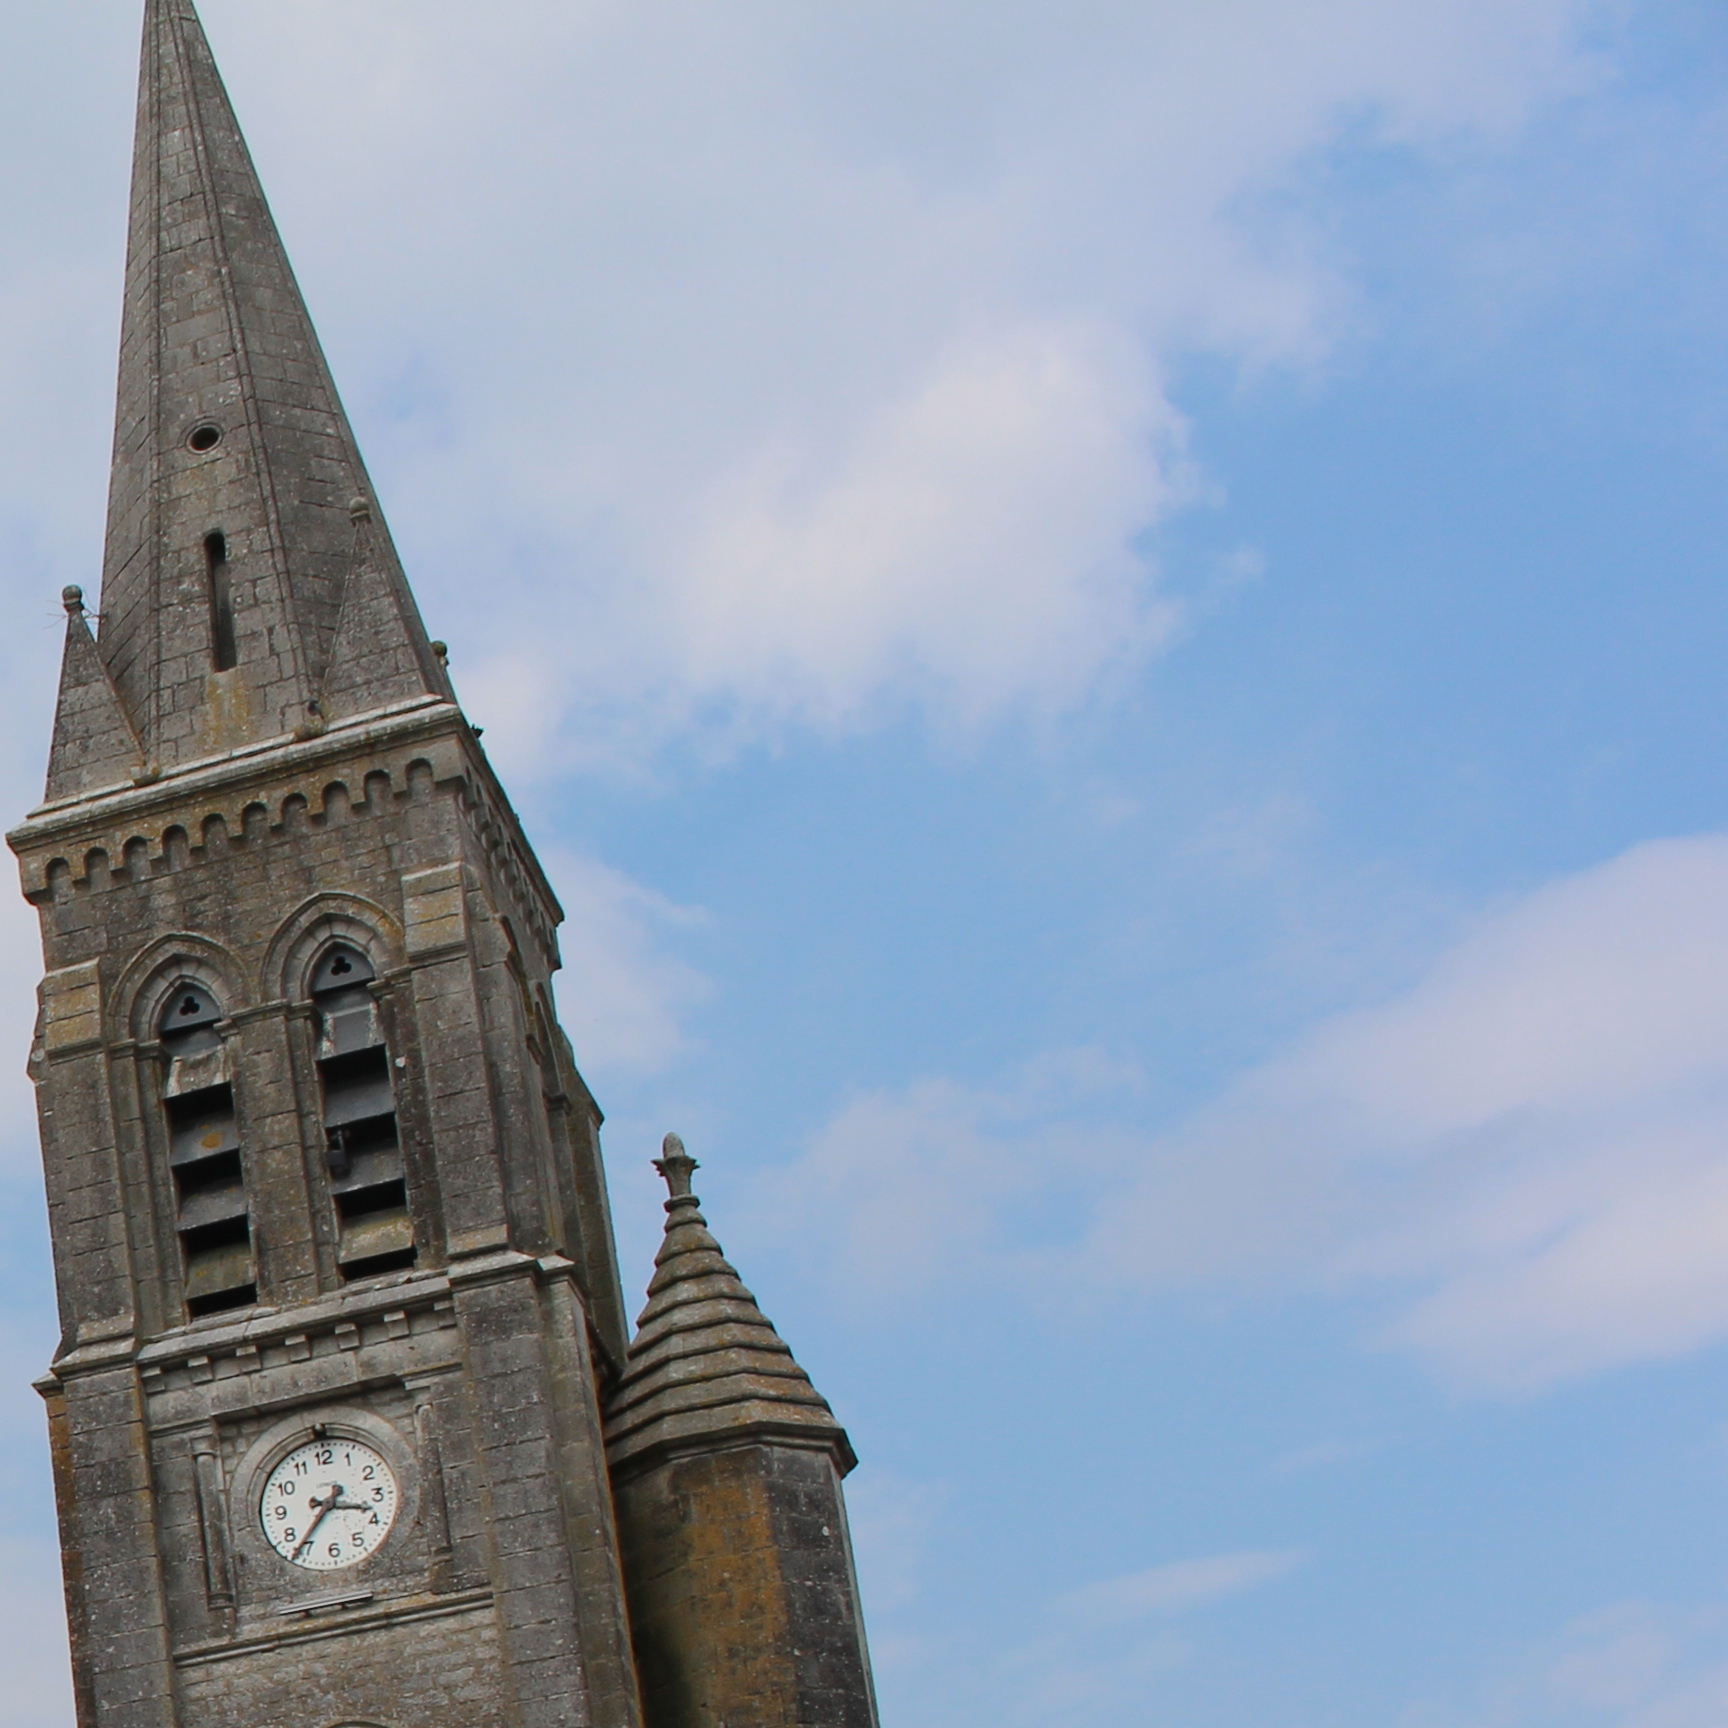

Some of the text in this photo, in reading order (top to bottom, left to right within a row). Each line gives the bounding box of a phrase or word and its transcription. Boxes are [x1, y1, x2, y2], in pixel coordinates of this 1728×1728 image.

[314, 1449, 333, 1466] 12
[344, 1453, 352, 1467] 1
[294, 1461, 308, 1476] 11
[362, 1466, 375, 1481] 2
[278, 1481, 295, 1496] 10
[372, 1488, 384, 1502] 3
[275, 1505, 287, 1520] 9
[368, 1513, 380, 1526] 4
[285, 1527, 296, 1542] 8
[352, 1532, 364, 1547] 5
[304, 1541, 314, 1556] 7
[329, 1543, 341, 1557] 6
